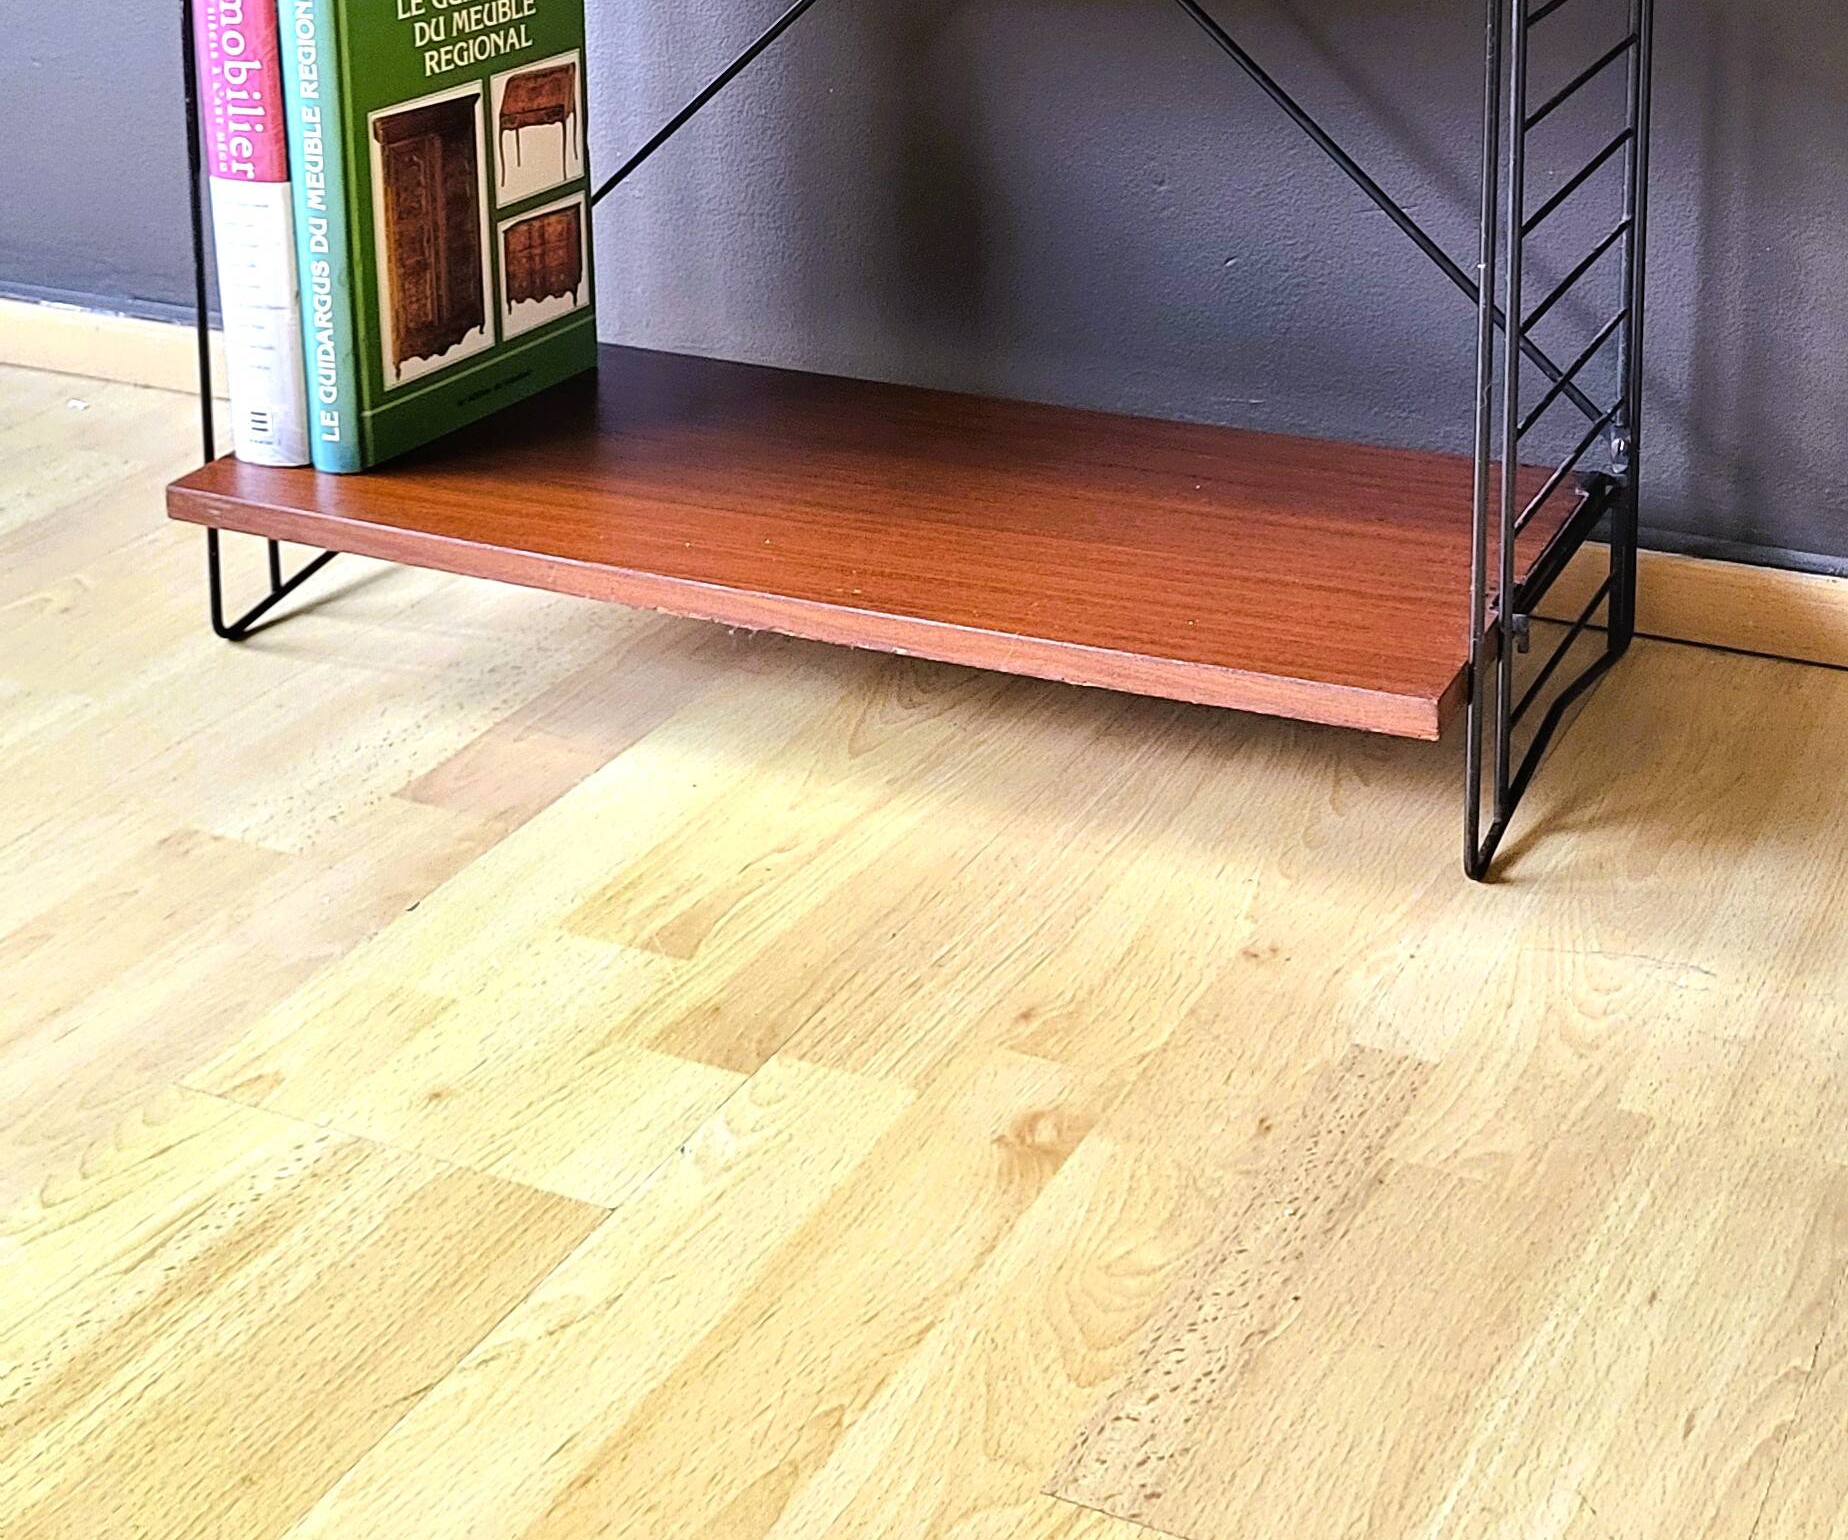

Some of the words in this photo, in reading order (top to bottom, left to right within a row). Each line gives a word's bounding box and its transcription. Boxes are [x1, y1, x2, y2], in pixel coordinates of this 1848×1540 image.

[413, 15, 447, 48] DU
[423, 24, 534, 77] REGIONAL
[301, 106, 327, 211] MEUBLE
[308, 217, 330, 254] DU
[310, 260, 338, 405] GUIDARGUS
[320, 410, 341, 443] LE
